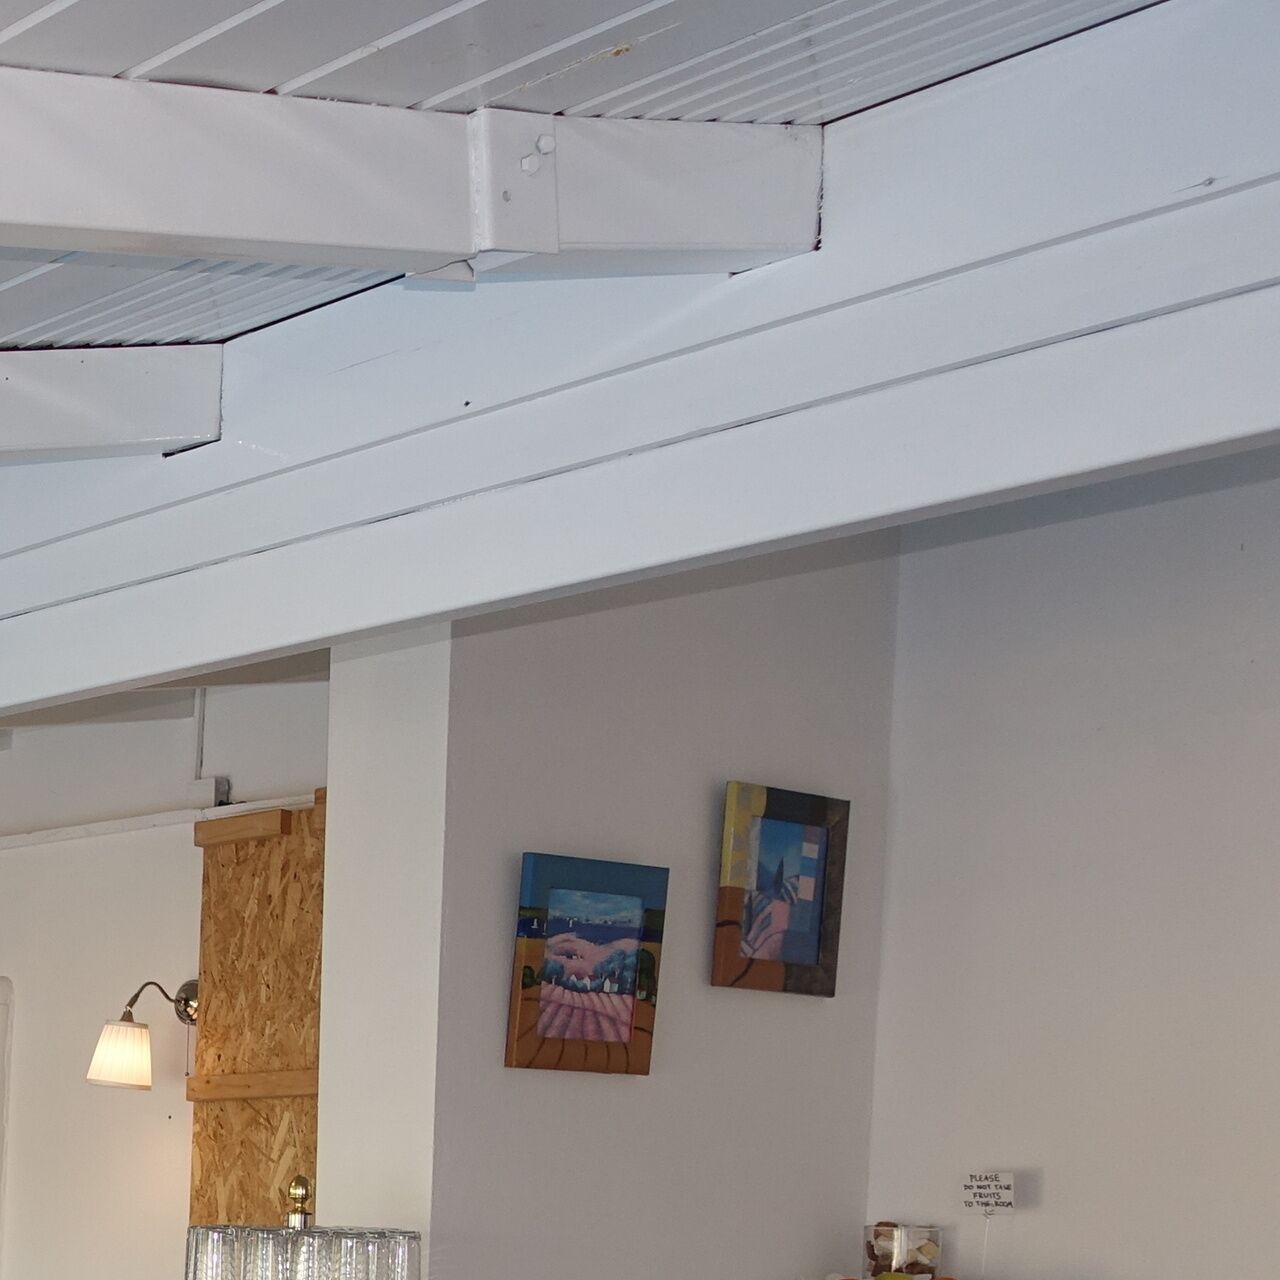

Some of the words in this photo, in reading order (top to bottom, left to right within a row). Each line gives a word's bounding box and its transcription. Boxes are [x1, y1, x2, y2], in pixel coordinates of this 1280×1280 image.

[969, 1174, 1000, 1182] PLEASE
[973, 1192, 1001, 1200] FRUITS
[993, 1200, 1013, 1208] ROOM
